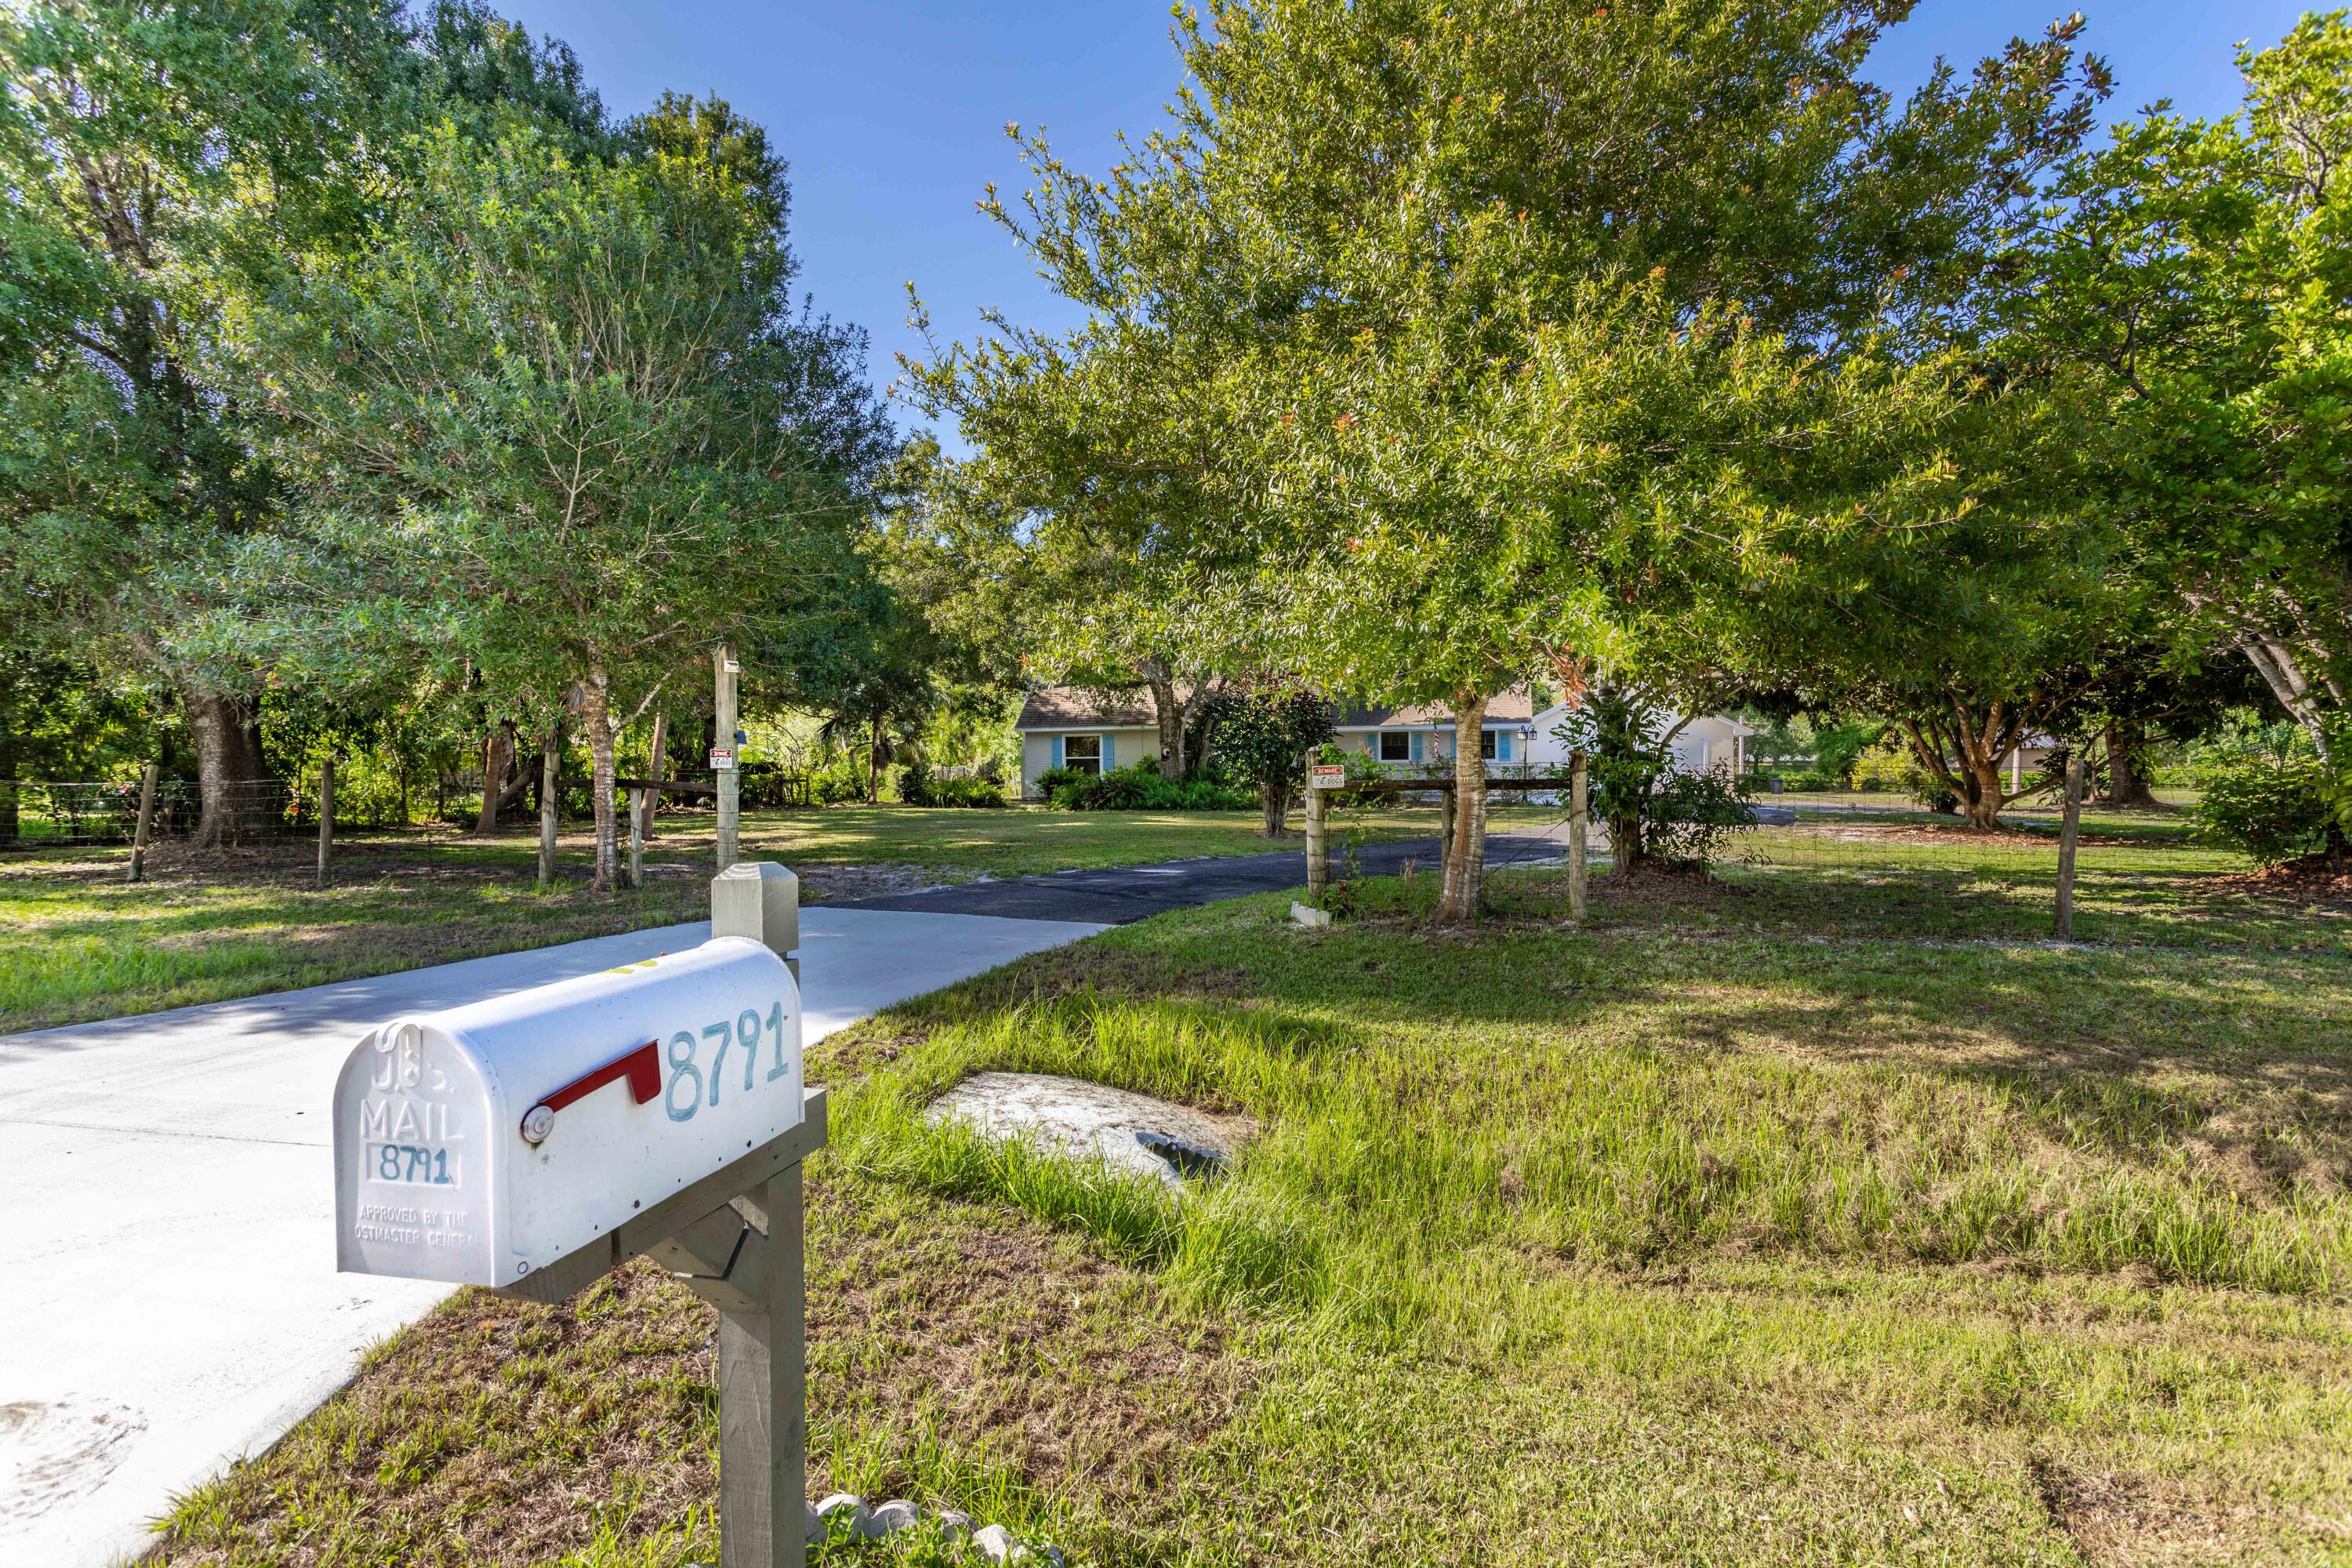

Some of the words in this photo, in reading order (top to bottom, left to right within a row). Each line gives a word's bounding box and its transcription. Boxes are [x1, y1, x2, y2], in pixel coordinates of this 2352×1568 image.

[666, 1001, 789, 1122] 8791
[361, 1099, 465, 1142] MAIL
[379, 1144, 450, 1185] 8791
[359, 1204, 416, 1224] APPROVED
[423, 1210, 439, 1225] BY
[354, 1223, 420, 1244] OSTMASTER
[427, 1231, 479, 1248] GENER
